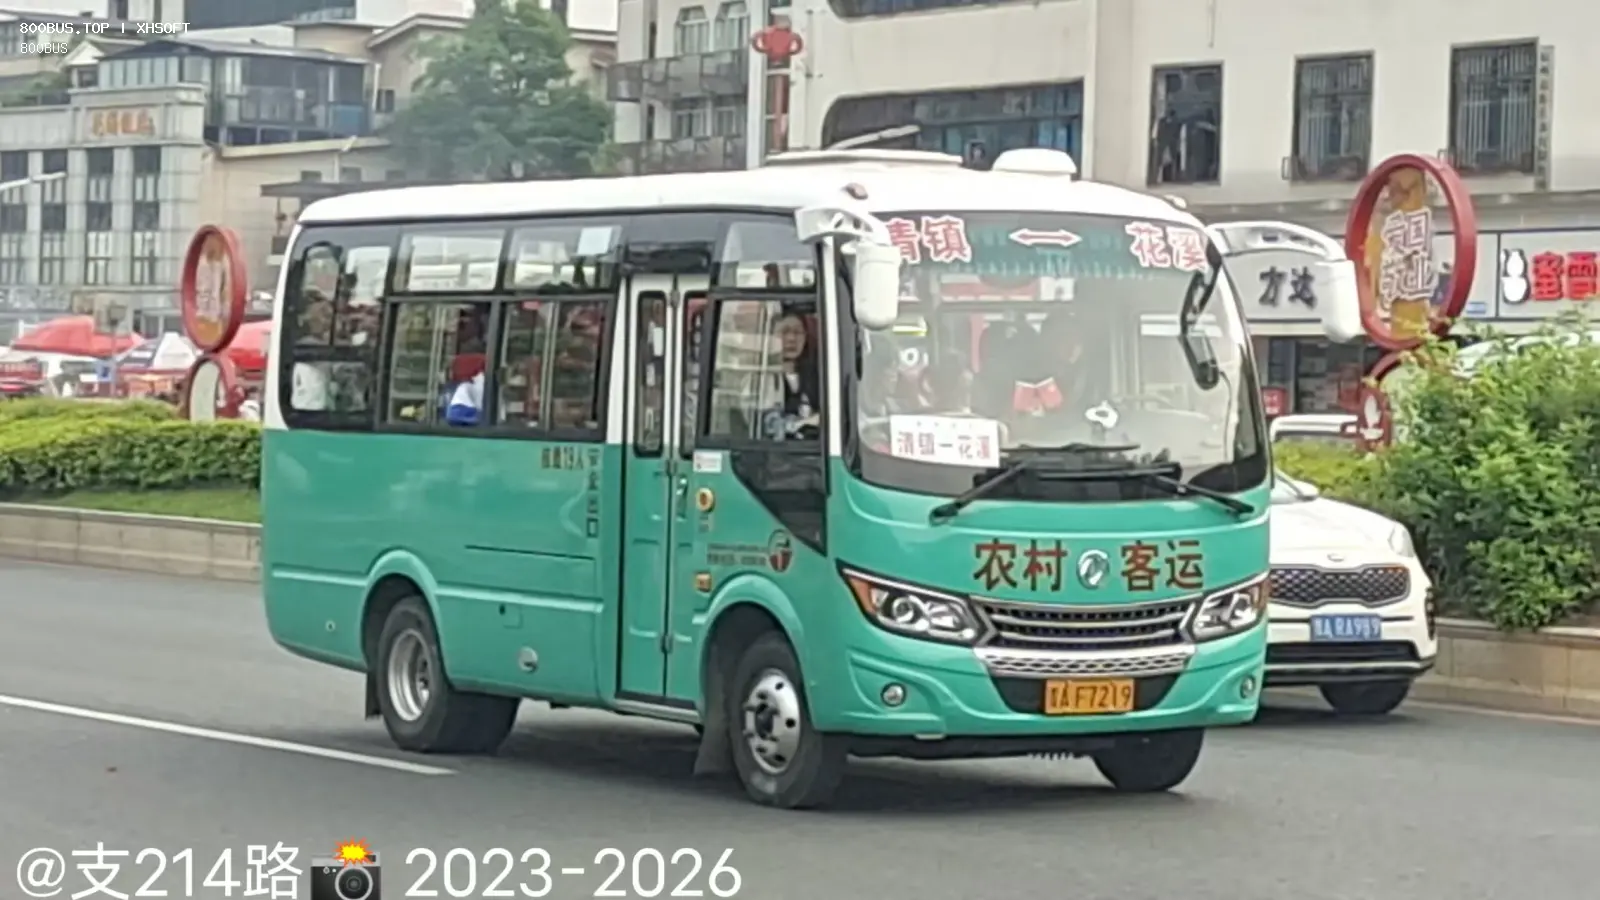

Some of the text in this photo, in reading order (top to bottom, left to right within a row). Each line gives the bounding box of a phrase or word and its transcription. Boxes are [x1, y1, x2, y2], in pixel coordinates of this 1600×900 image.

[1125, 221, 1206, 272] 花溪
[1259, 266, 1317, 311] 方达
[973, 538, 1204, 592] 农村 客运
